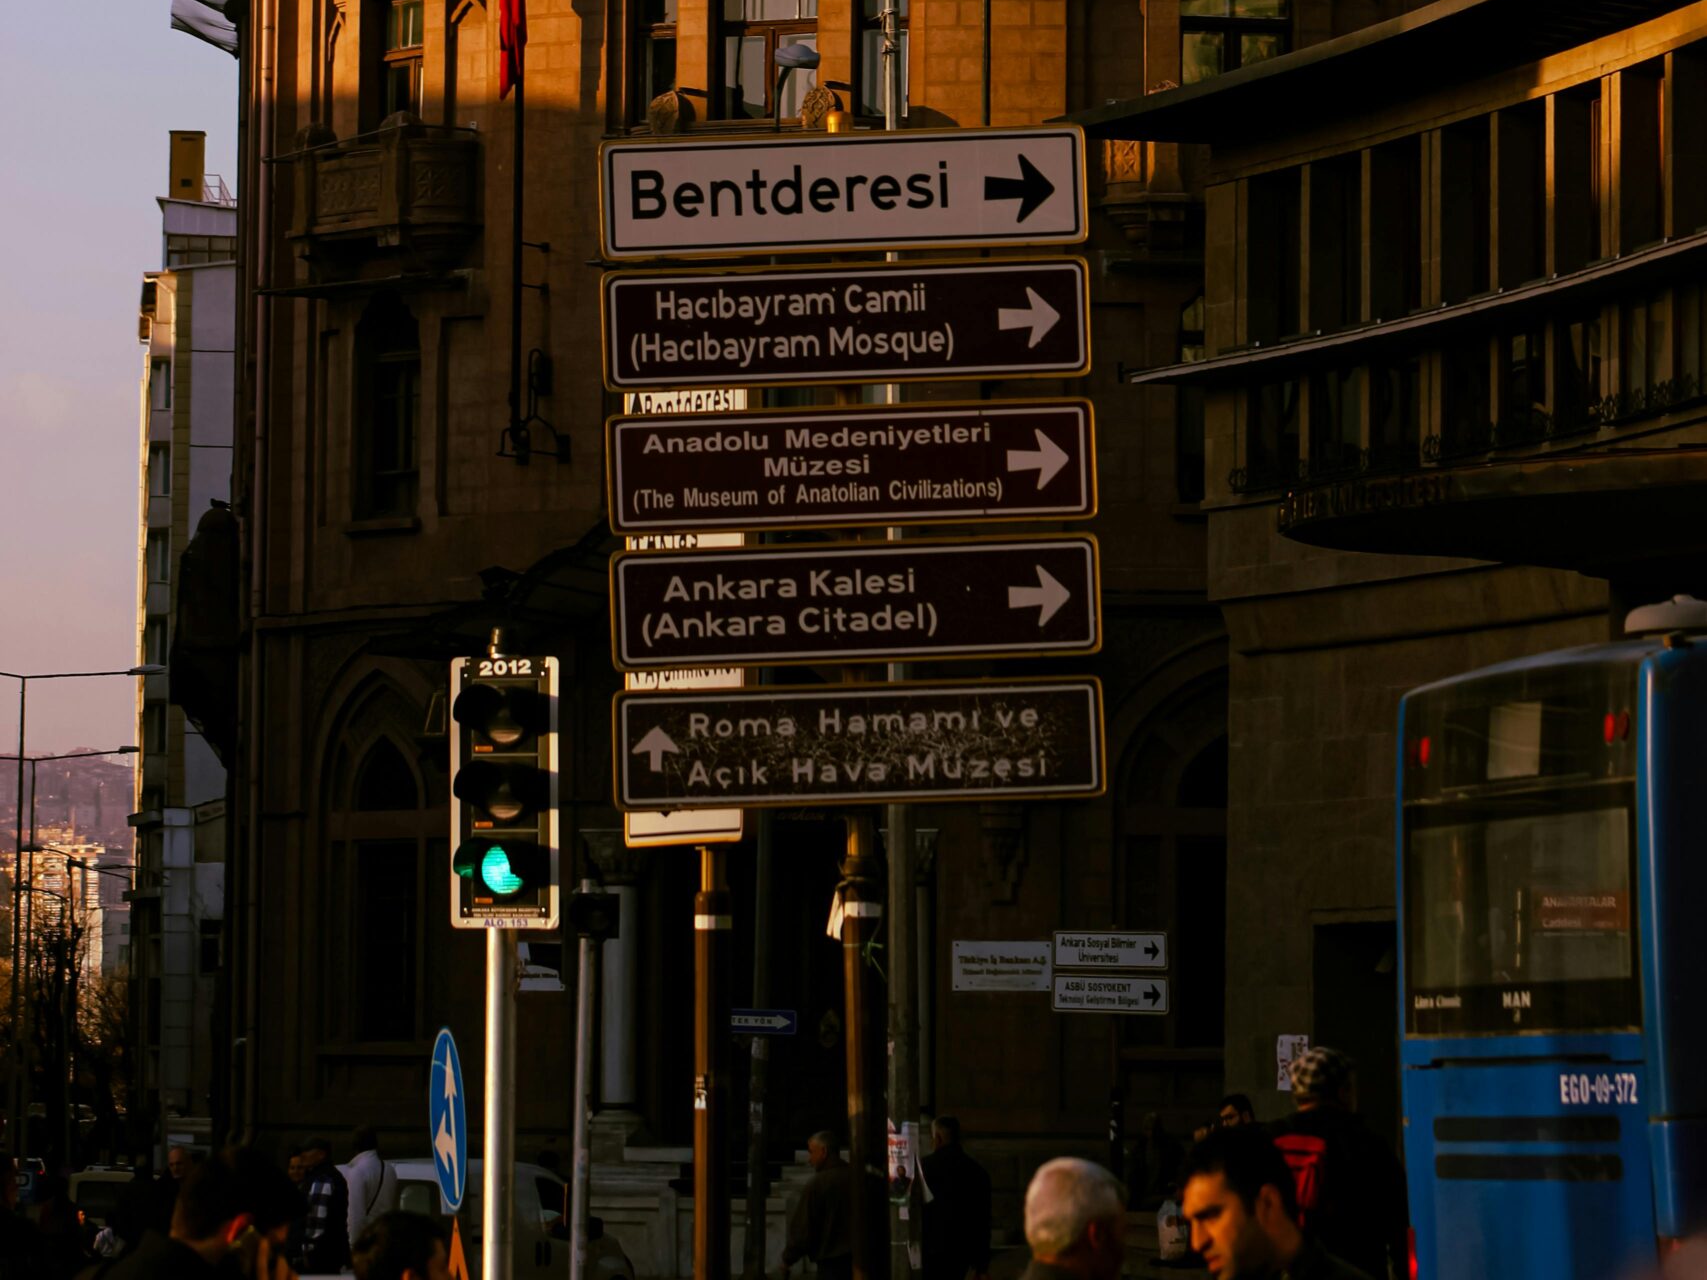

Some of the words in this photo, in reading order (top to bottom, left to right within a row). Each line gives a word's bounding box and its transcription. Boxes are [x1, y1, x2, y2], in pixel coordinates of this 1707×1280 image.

[630, 160, 950, 220] Bentderesi
[655, 286, 836, 325] Hacıbayram
[844, 282, 927, 316] Camii
[629, 331, 821, 372] (Hacıbayram
[829, 322, 956, 363] Mosque)
[642, 430, 769, 455] Anadolu
[785, 422, 991, 451] Medeniyetleri
[763, 454, 871, 478] Müzesi
[632, 488, 675, 514] (The
[683, 486, 759, 509] Museum
[767, 483, 786, 505] of
[795, 479, 880, 504] Anatolian
[889, 475, 1004, 501] Civilizations)
[663, 574, 798, 602] Ankara
[809, 567, 916, 597] Kalesi
[642, 611, 786, 647] (Ankara
[798, 602, 939, 638] Citadel)
[478, 657, 533, 677] 2012
[687, 711, 797, 741] Roma
[818, 708, 980, 736] Hamamı
[999, 707, 1040, 729] ve
[687, 758, 769, 791] Açık
[791, 757, 888, 784] Hava
[1060, 936, 1086, 948] Ankara
[1087, 937, 1110, 950] Sosyal
[1078, 949, 1119, 963] Üniversitesi
[1064, 980, 1086, 992] ASBÜ
[1087, 982, 1131, 993] SOSYOKENT
[1502, 990, 1532, 1009] MAN
[1559, 1071, 1639, 1105] EGO-09-372
